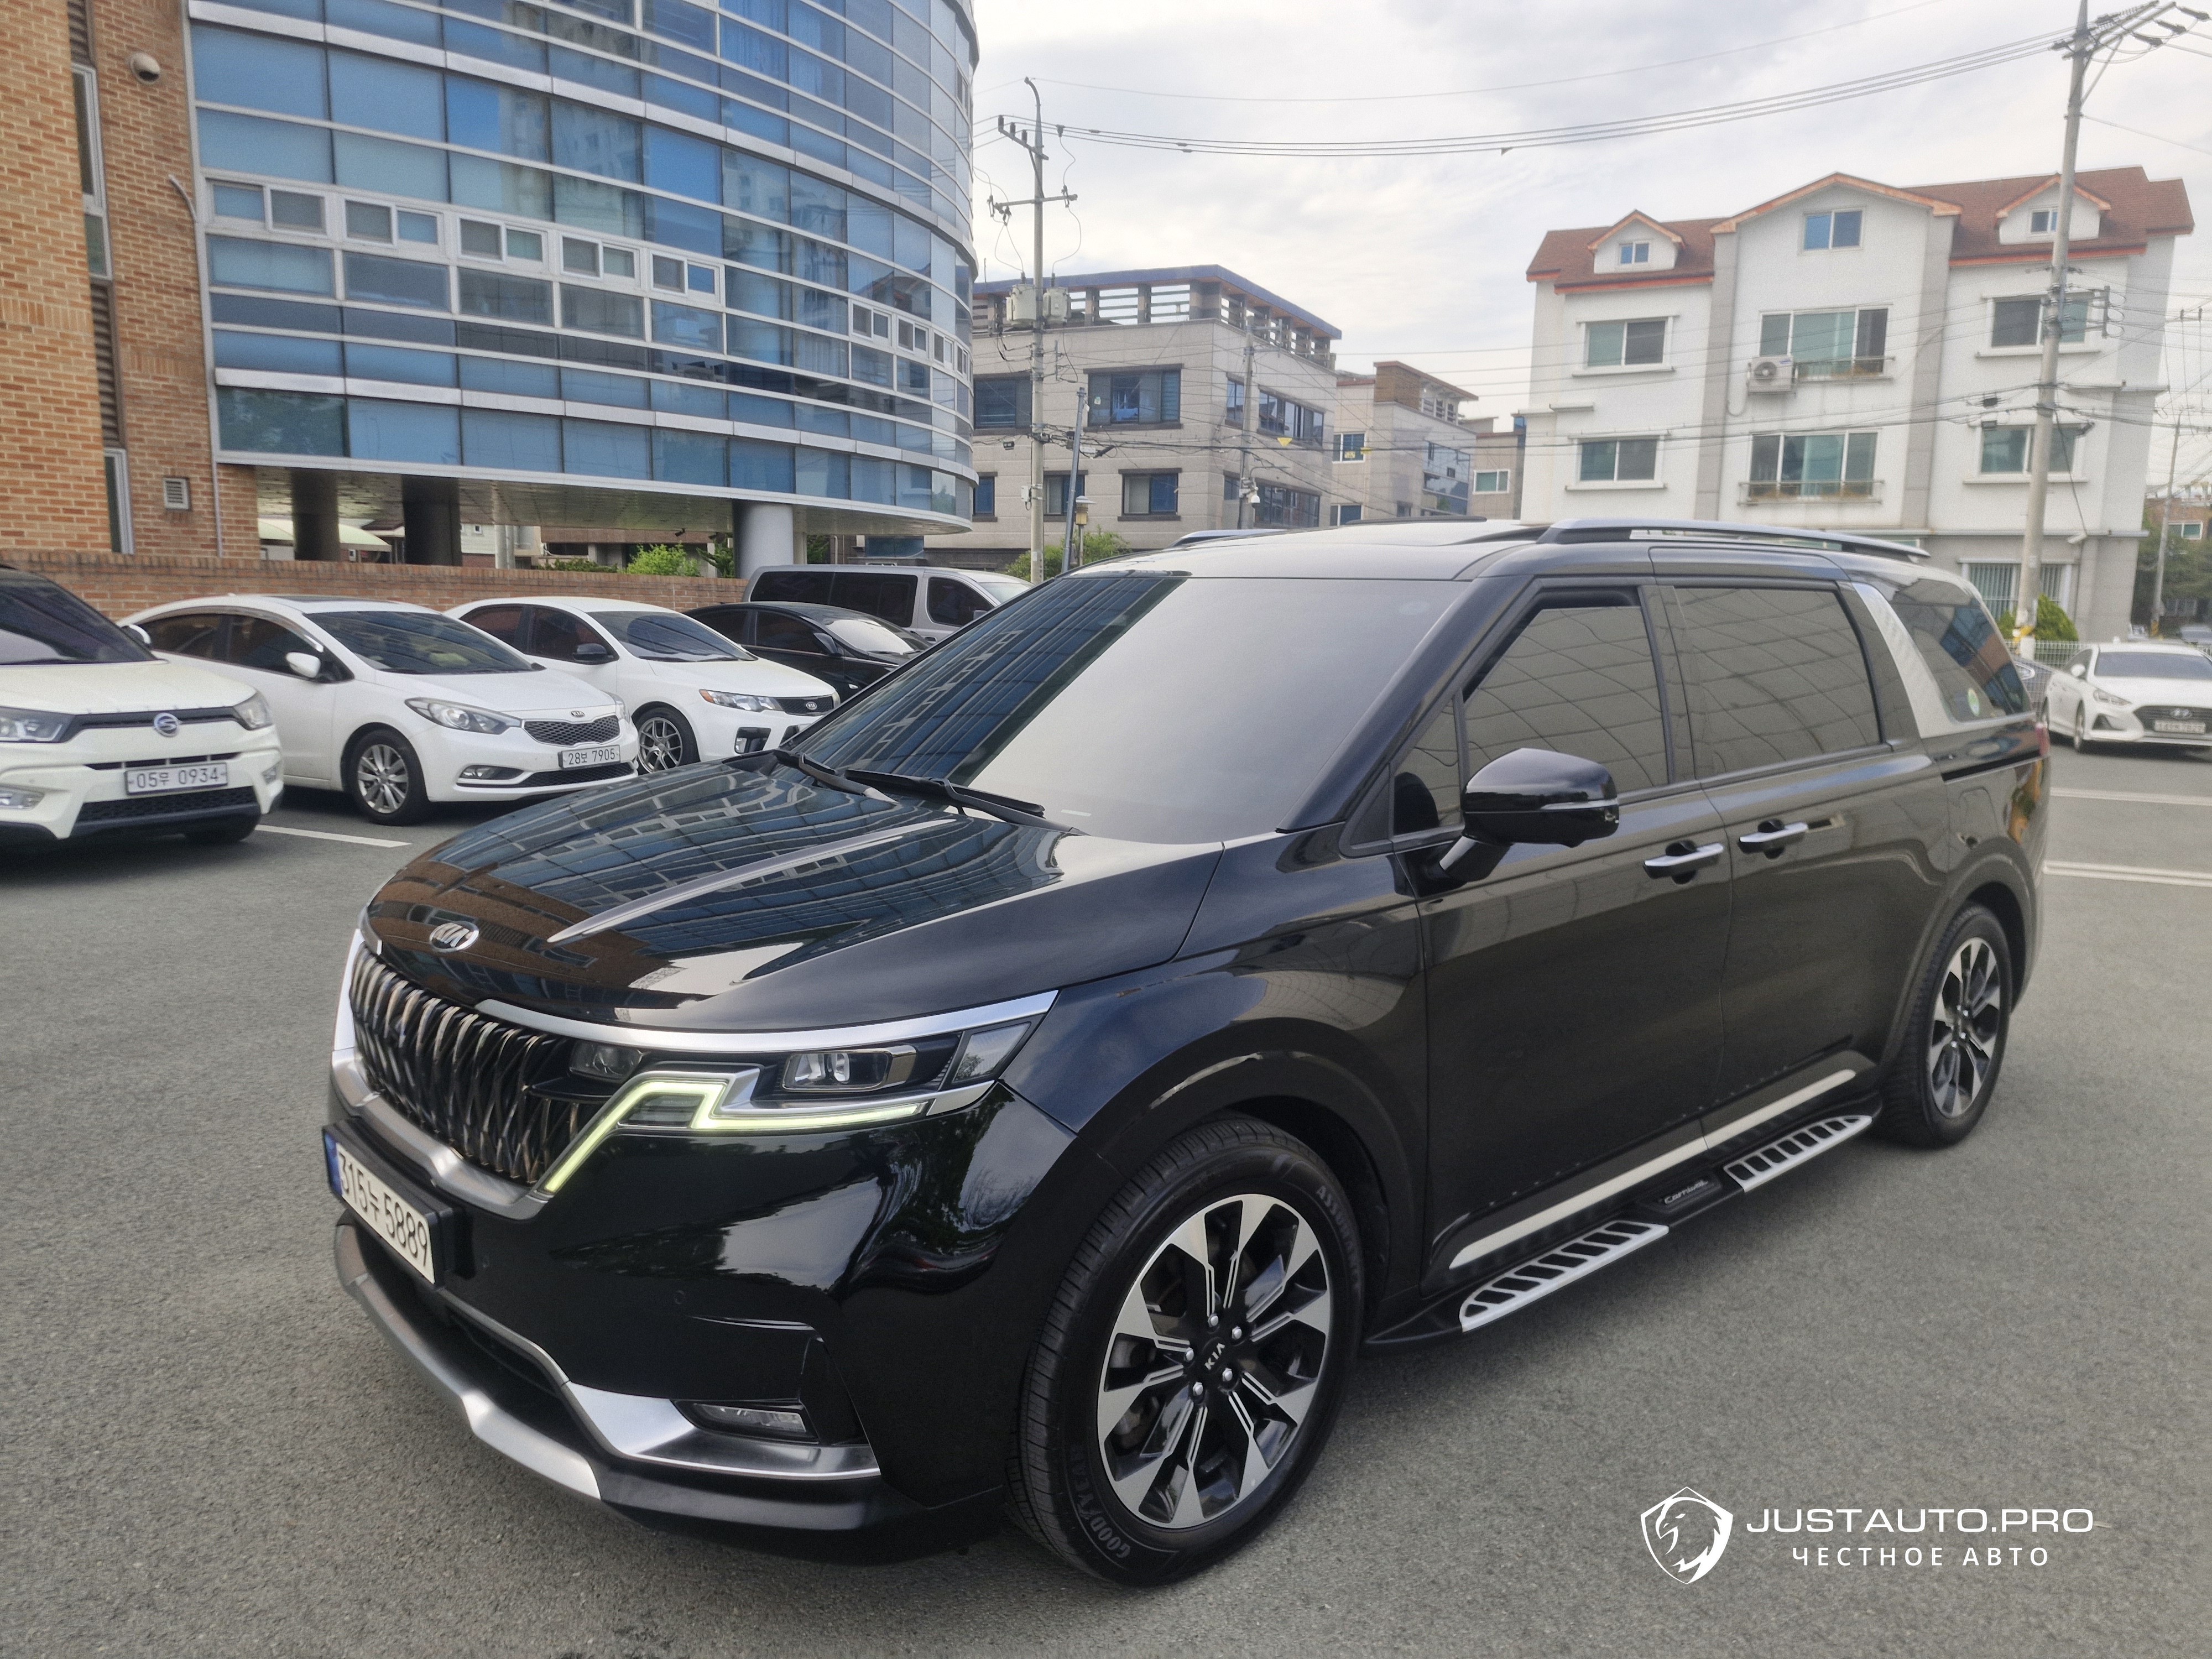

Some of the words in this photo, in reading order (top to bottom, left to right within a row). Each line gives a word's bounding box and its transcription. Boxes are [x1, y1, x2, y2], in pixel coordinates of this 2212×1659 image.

[568, 752, 587, 765] 28보
[592, 748, 615, 762] 7905
[179, 768, 218, 784] 0934
[339, 1152, 379, 1222] 315누
[384, 1192, 427, 1267] 5889
[1204, 1343, 1225, 1370] KIA
